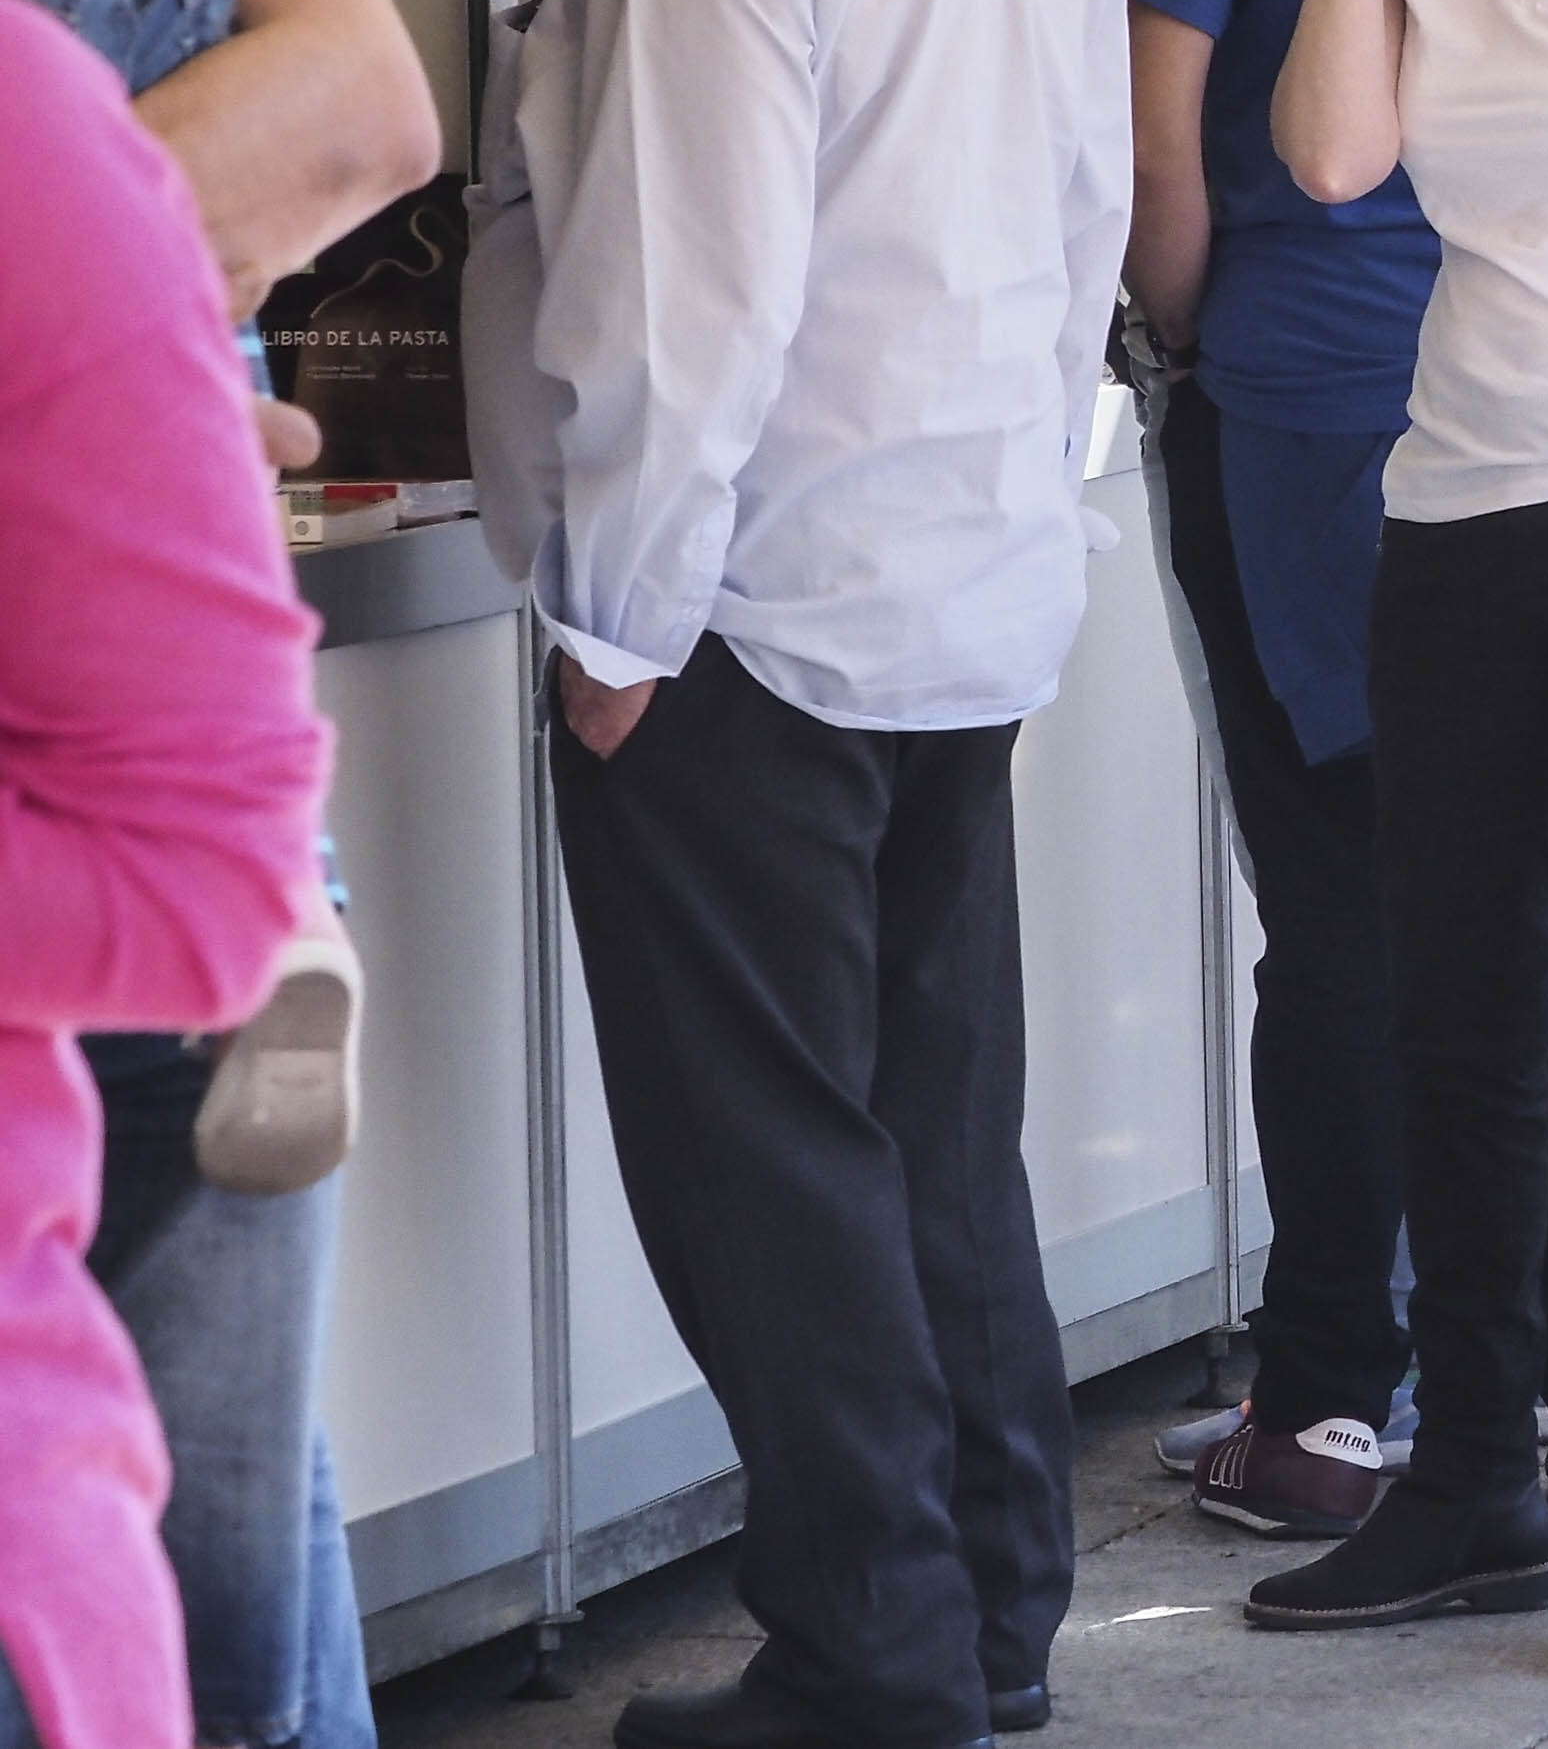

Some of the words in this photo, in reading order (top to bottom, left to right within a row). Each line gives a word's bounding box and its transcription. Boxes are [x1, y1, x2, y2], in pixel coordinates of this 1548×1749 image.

[262, 330, 320, 347] LIBRO
[326, 331, 351, 346] DE
[357, 331, 383, 346] LA
[389, 330, 450, 346] PASTA
